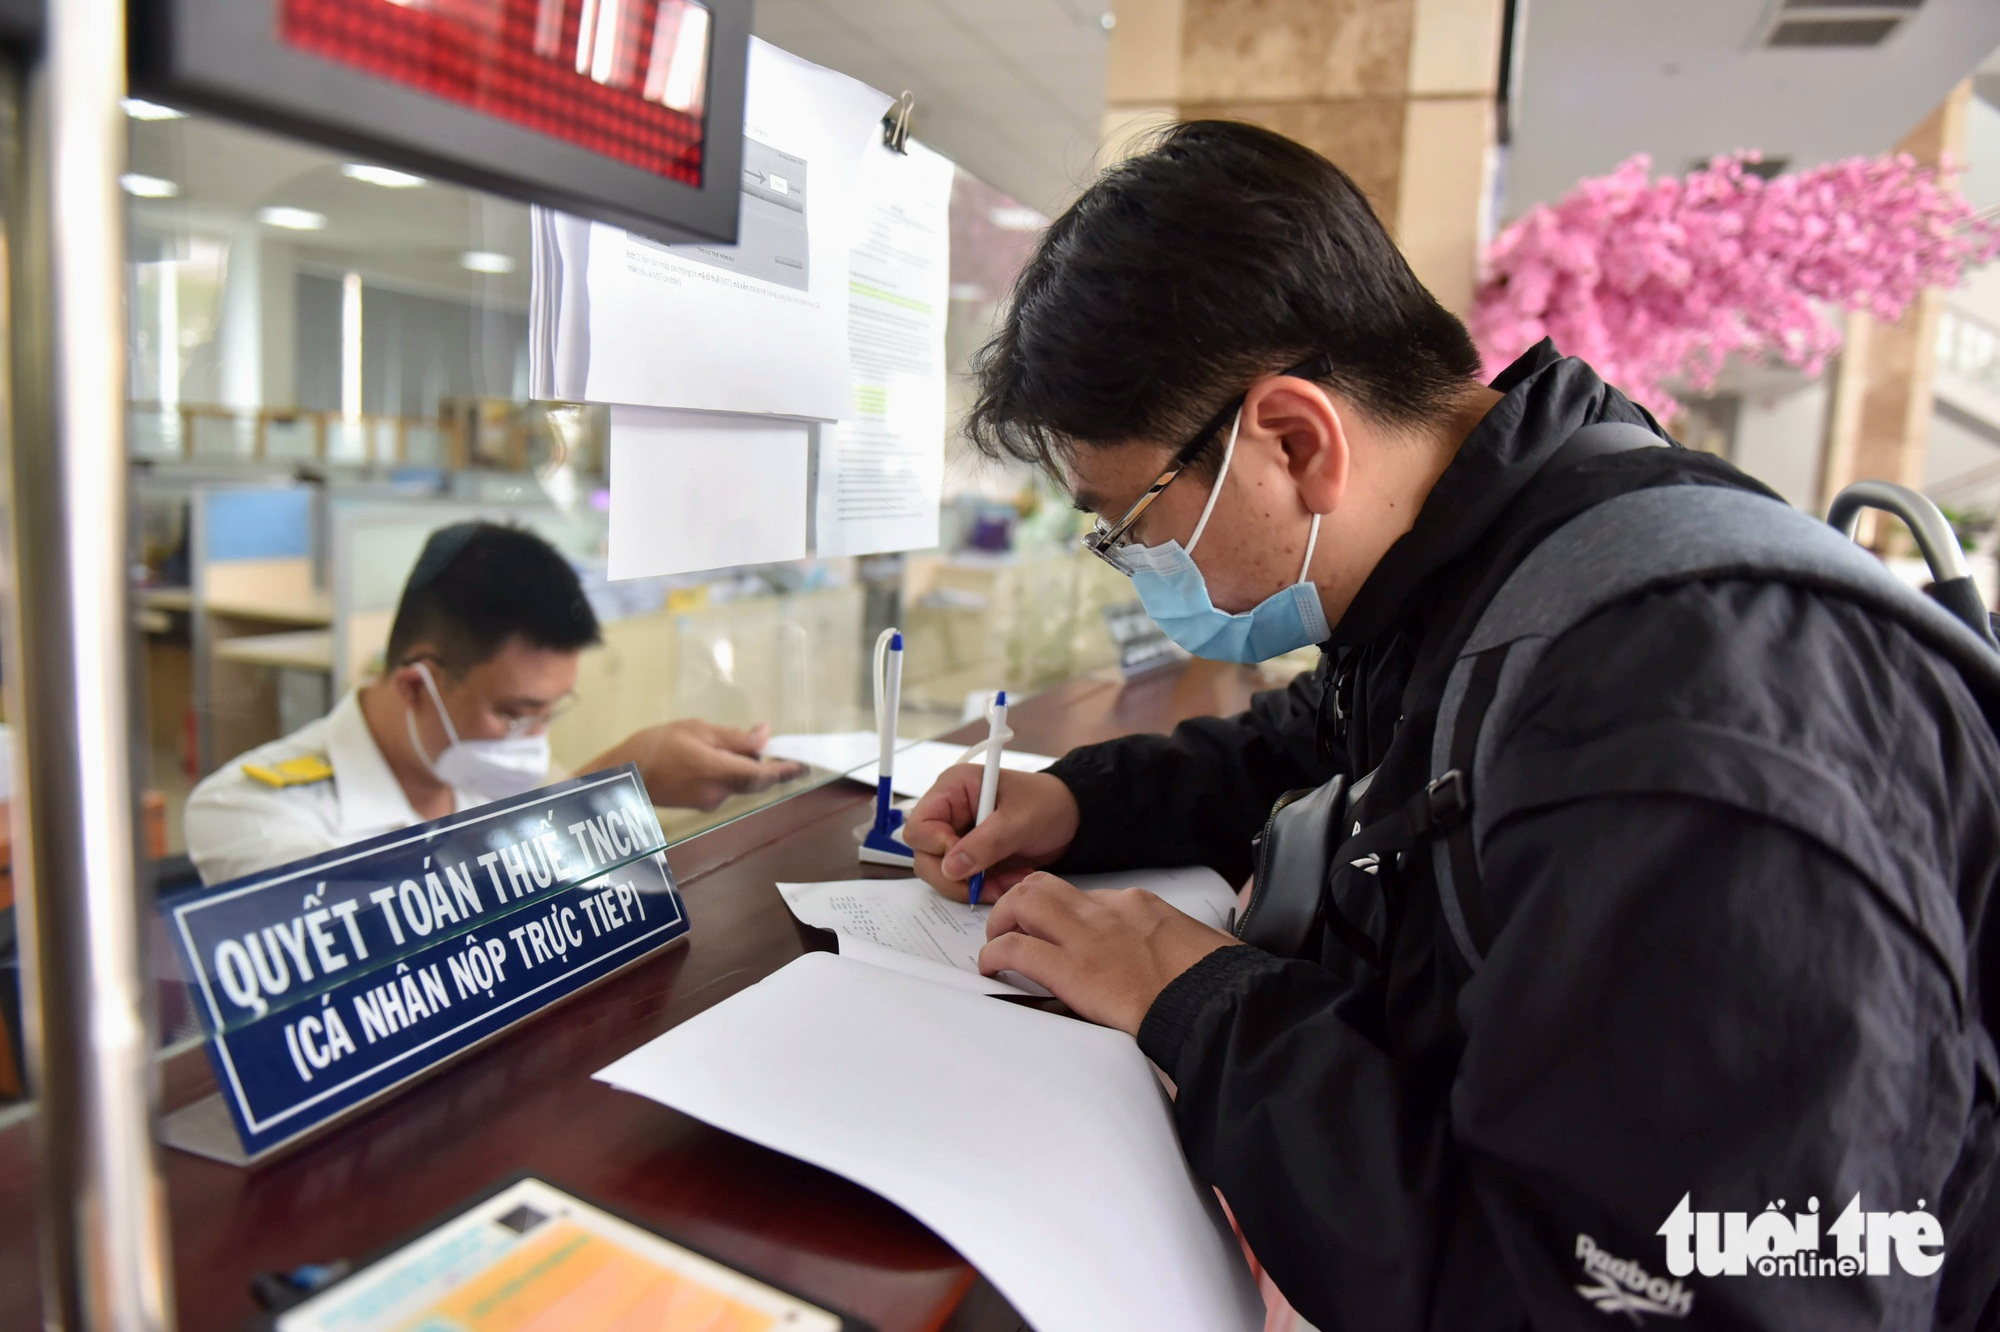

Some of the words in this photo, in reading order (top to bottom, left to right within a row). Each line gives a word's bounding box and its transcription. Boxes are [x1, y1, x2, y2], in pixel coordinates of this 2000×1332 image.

[216, 882, 370, 1018] QUYẾT
[370, 857, 484, 946] TOÁN
[478, 810, 573, 905] THUẾ
[567, 806, 651, 870] TNCN
[284, 994, 356, 1082] (CÁ
[352, 963, 452, 1044] NHÂN
[447, 937, 507, 999] NỘP
[510, 904, 583, 972] TRỰC
[580, 873, 647, 937] TIẾP)
